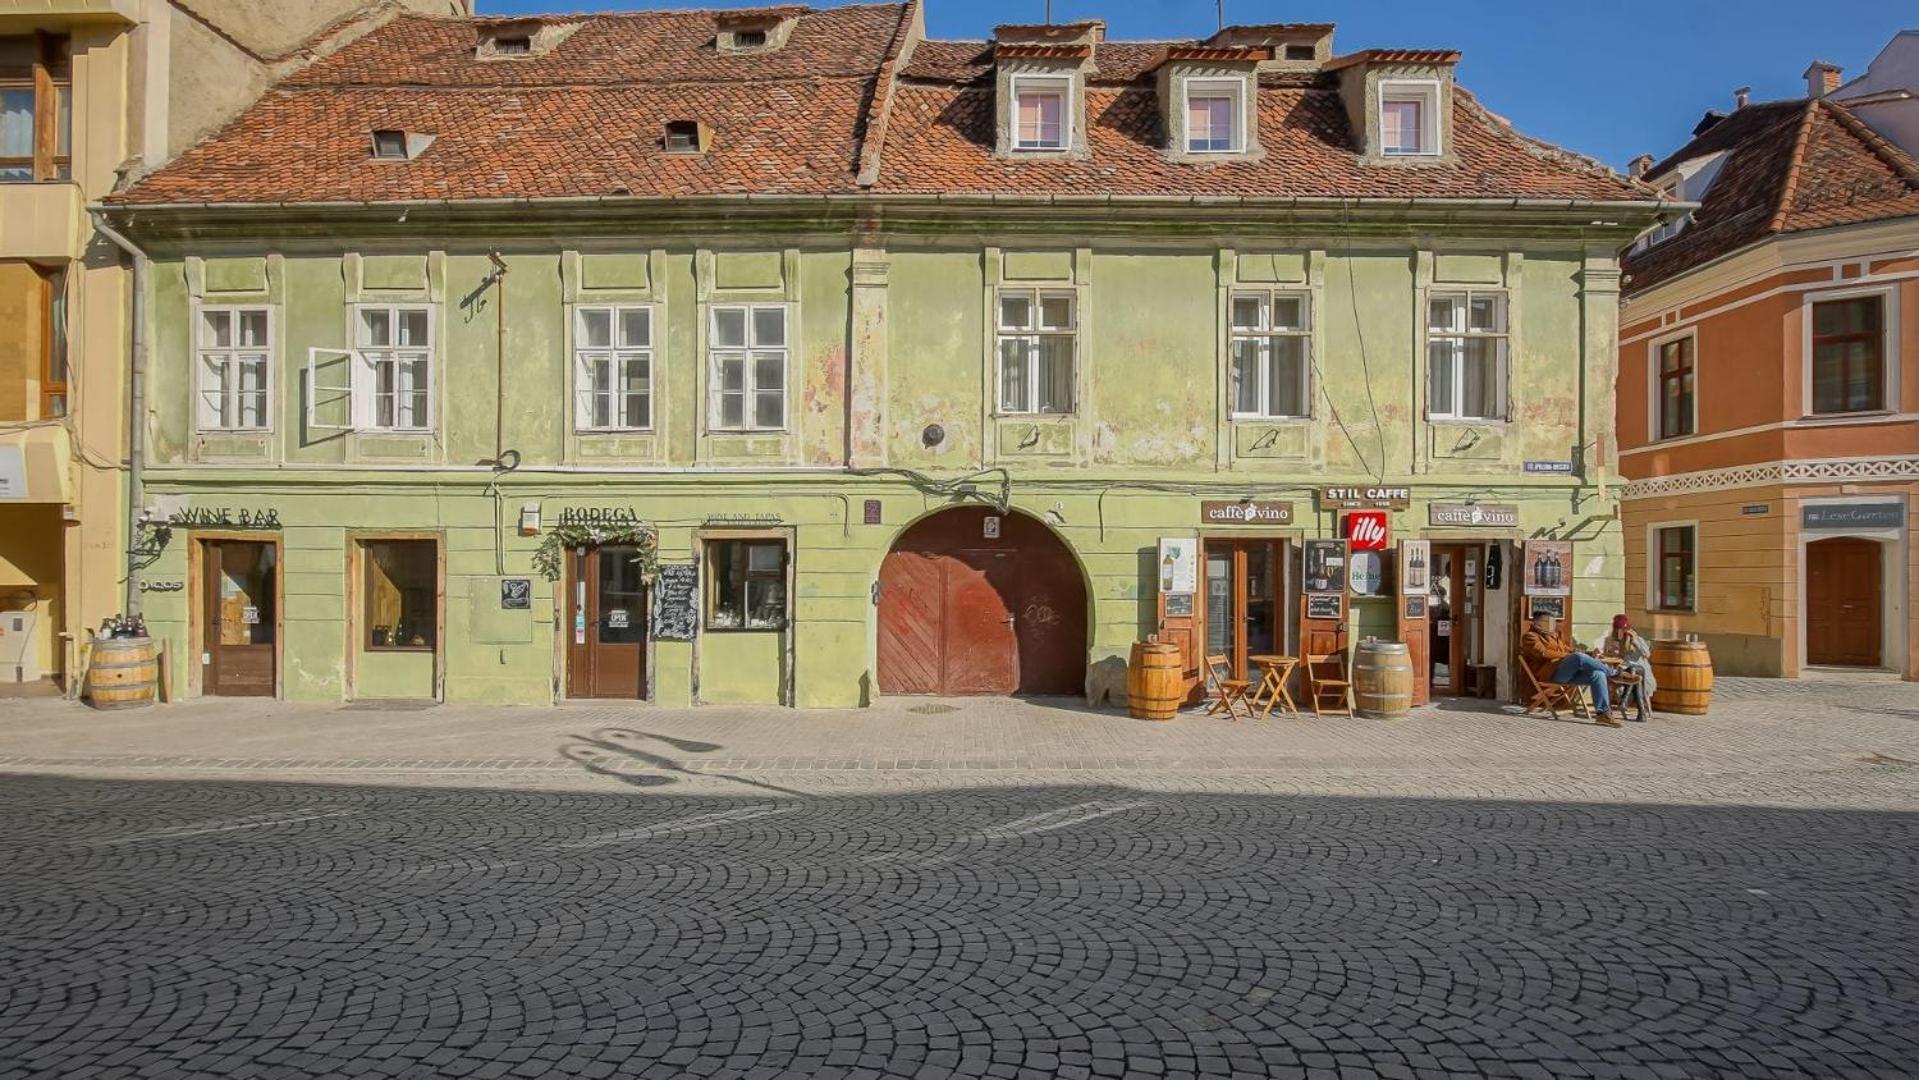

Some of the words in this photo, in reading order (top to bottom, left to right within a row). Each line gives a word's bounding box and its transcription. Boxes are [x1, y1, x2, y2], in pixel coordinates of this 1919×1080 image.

[1327, 488, 1360, 499] STIL
[1366, 488, 1409, 499] CAFFE
[180, 506, 232, 523] WINE
[240, 507, 280, 525] BAR
[563, 505, 638, 521] BODEGA
[1209, 505, 1244, 519] caffè
[1256, 506, 1288, 519] vino
[1480, 509, 1514, 523] vino
[1351, 516, 1385, 548] illy
